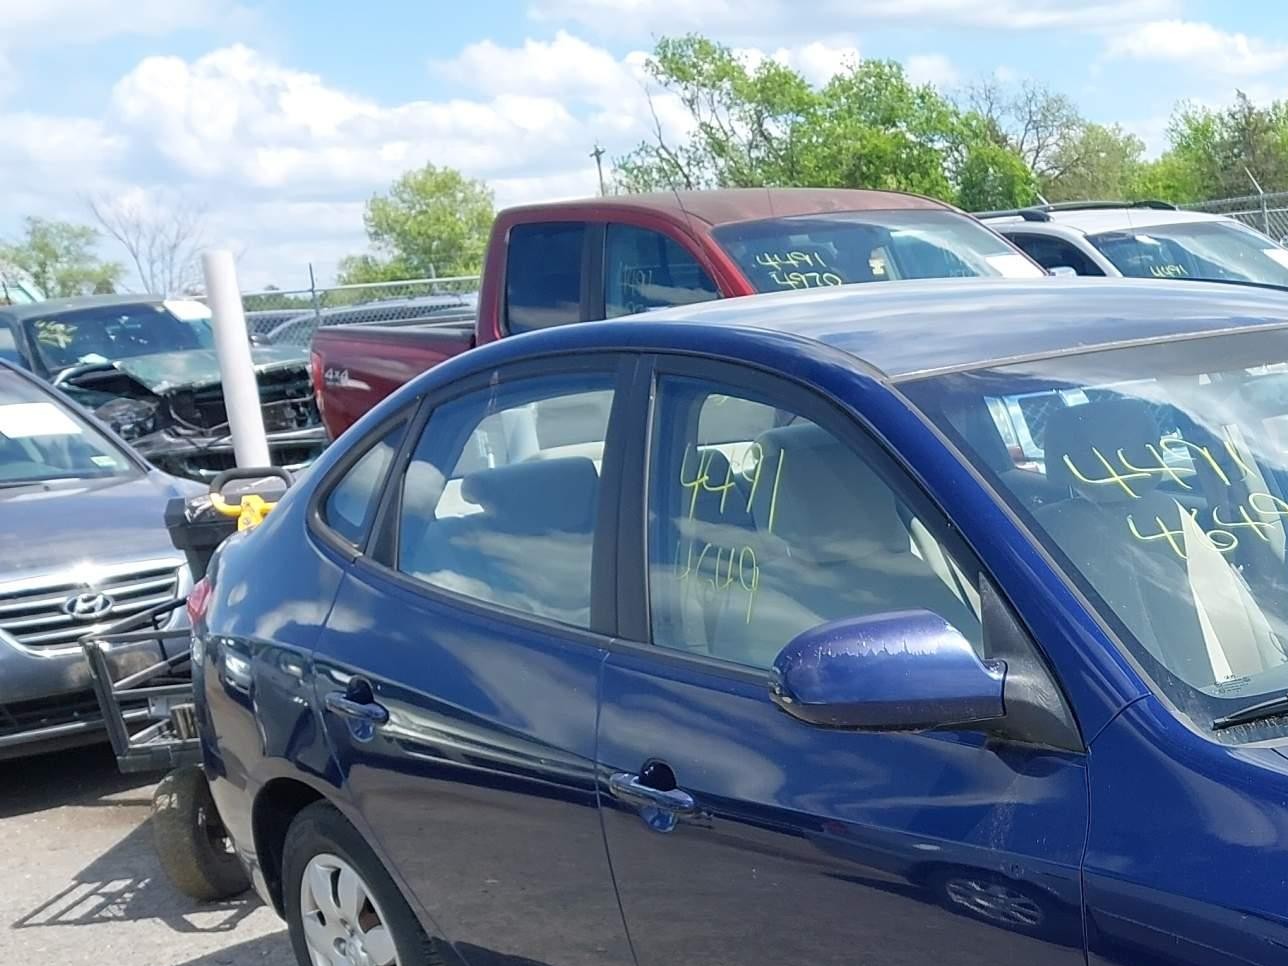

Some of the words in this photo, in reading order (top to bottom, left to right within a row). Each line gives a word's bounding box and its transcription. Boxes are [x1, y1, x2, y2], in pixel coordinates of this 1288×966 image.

[756, 251, 827, 270] 4491
[680, 442, 784, 533] 4491
[1063, 436, 1258, 499] 4491
